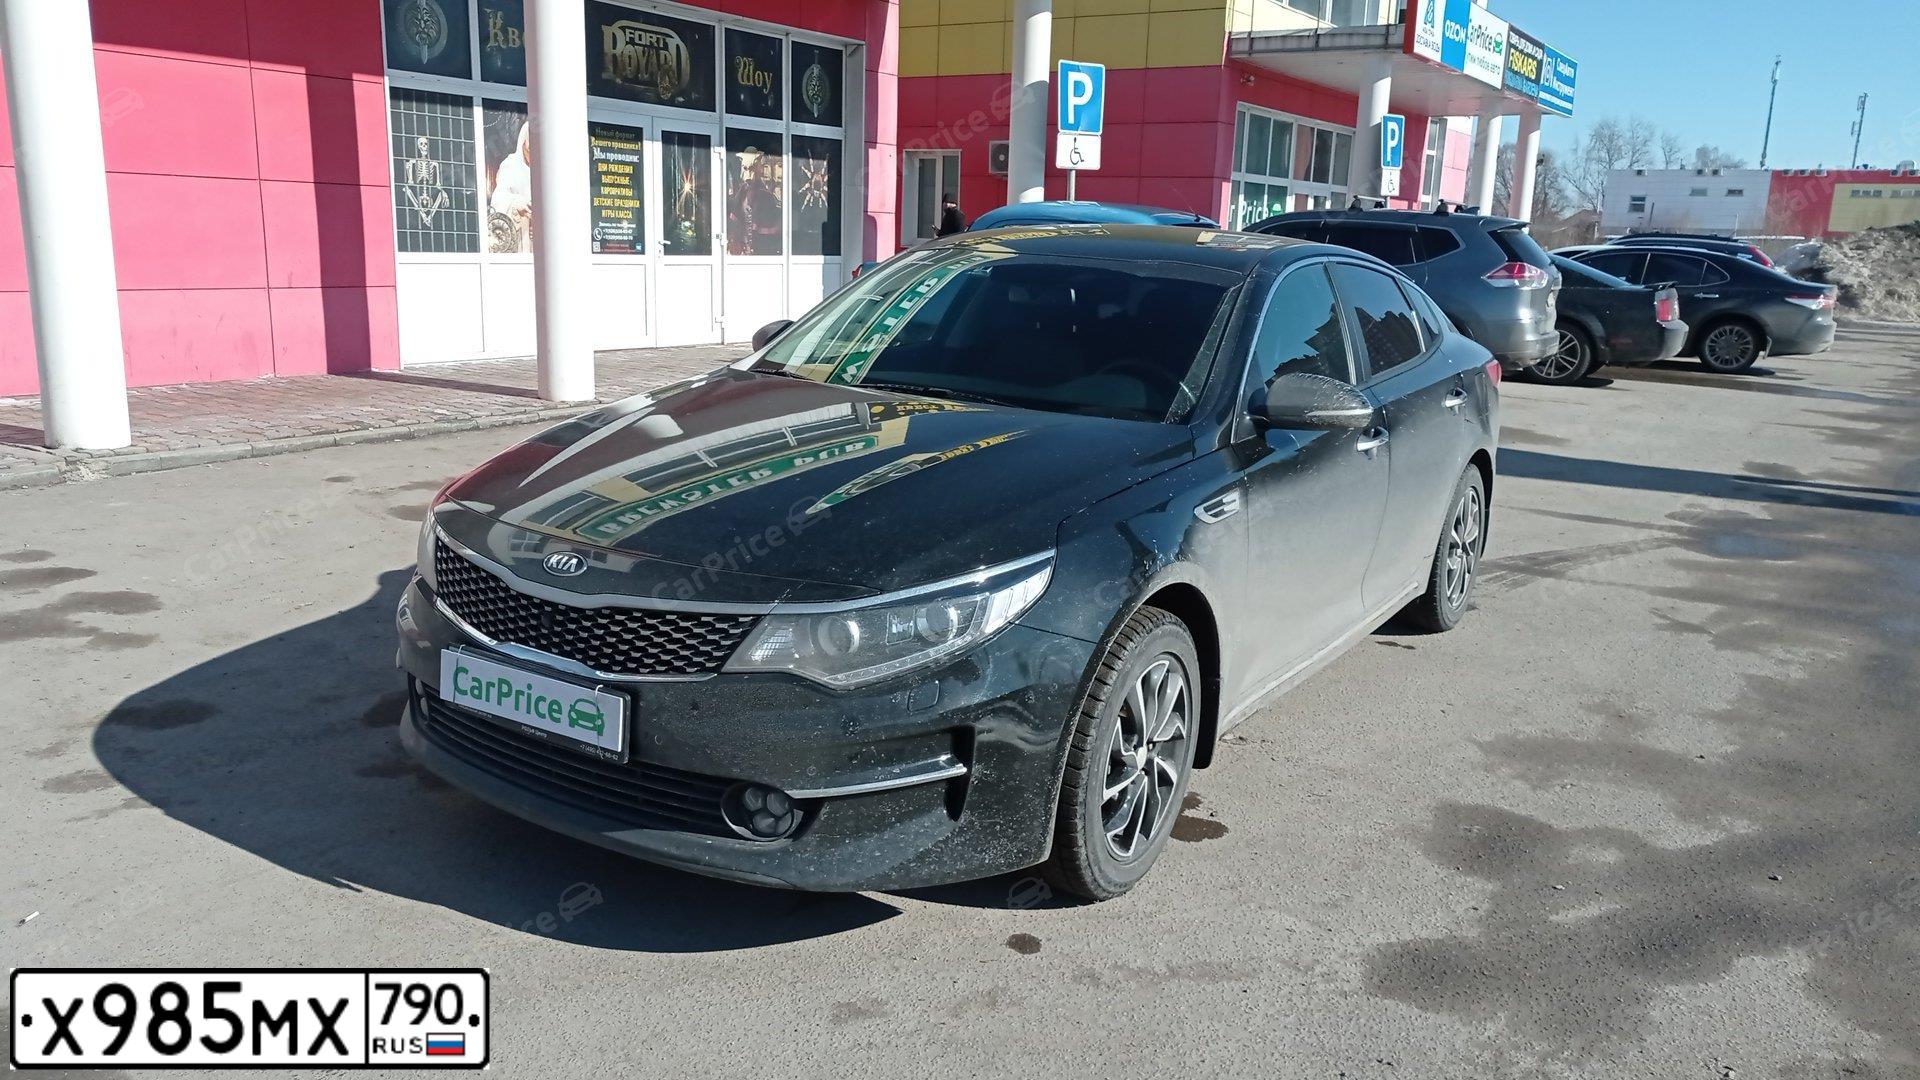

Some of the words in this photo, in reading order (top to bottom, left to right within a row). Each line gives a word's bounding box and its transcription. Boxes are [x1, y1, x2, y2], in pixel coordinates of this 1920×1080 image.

[484, 8, 525, 50] Кв
[626, 29, 664, 48] FORT
[1445, 19, 1466, 44] OZON
[1068, 71, 1093, 124] P
[1386, 122, 1399, 161] P
[549, 553, 577, 573] KIA
[453, 666, 563, 724] CarPrice
